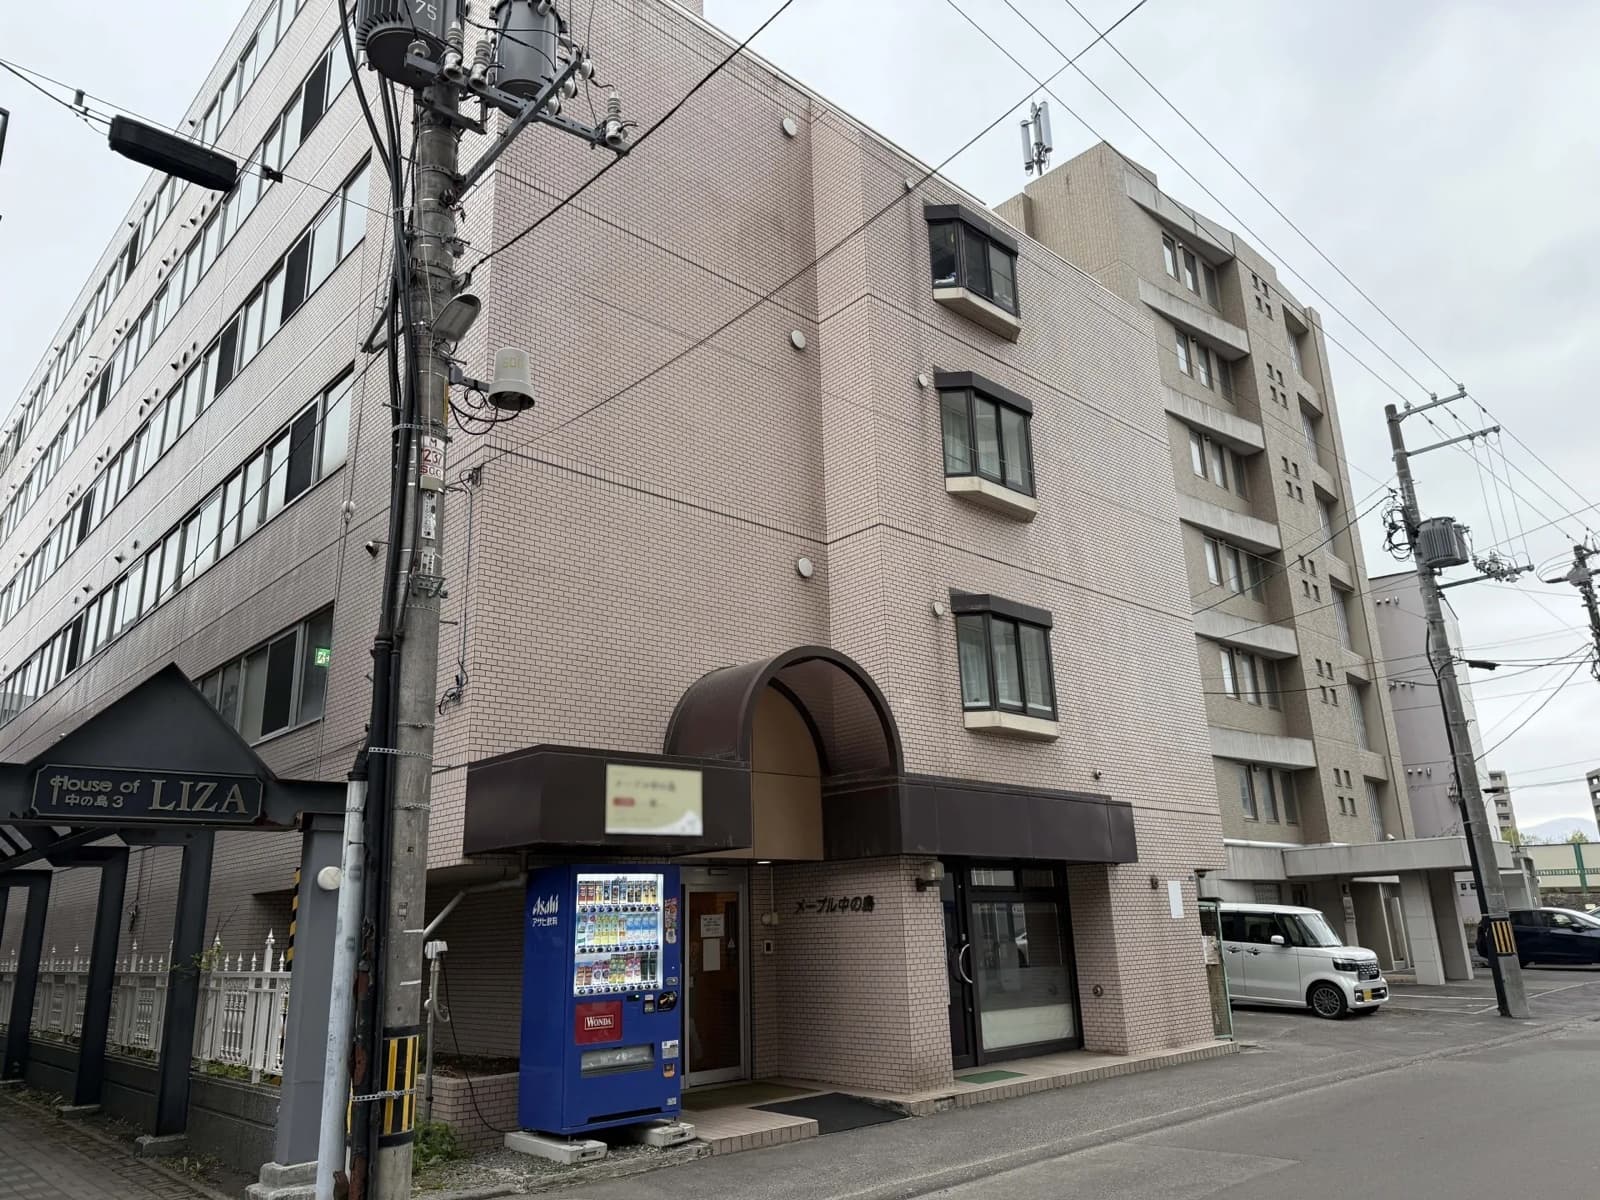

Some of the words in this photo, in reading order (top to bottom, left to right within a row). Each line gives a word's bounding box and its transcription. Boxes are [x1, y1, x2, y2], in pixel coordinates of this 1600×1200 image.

[415, 0, 437, 20] 75
[50, 775, 113, 805] House
[119, 779, 140, 794] of
[148, 779, 249, 814] LIZA
[532, 894, 559, 916] Asahi
[586, 1015, 612, 1028] WONDA
